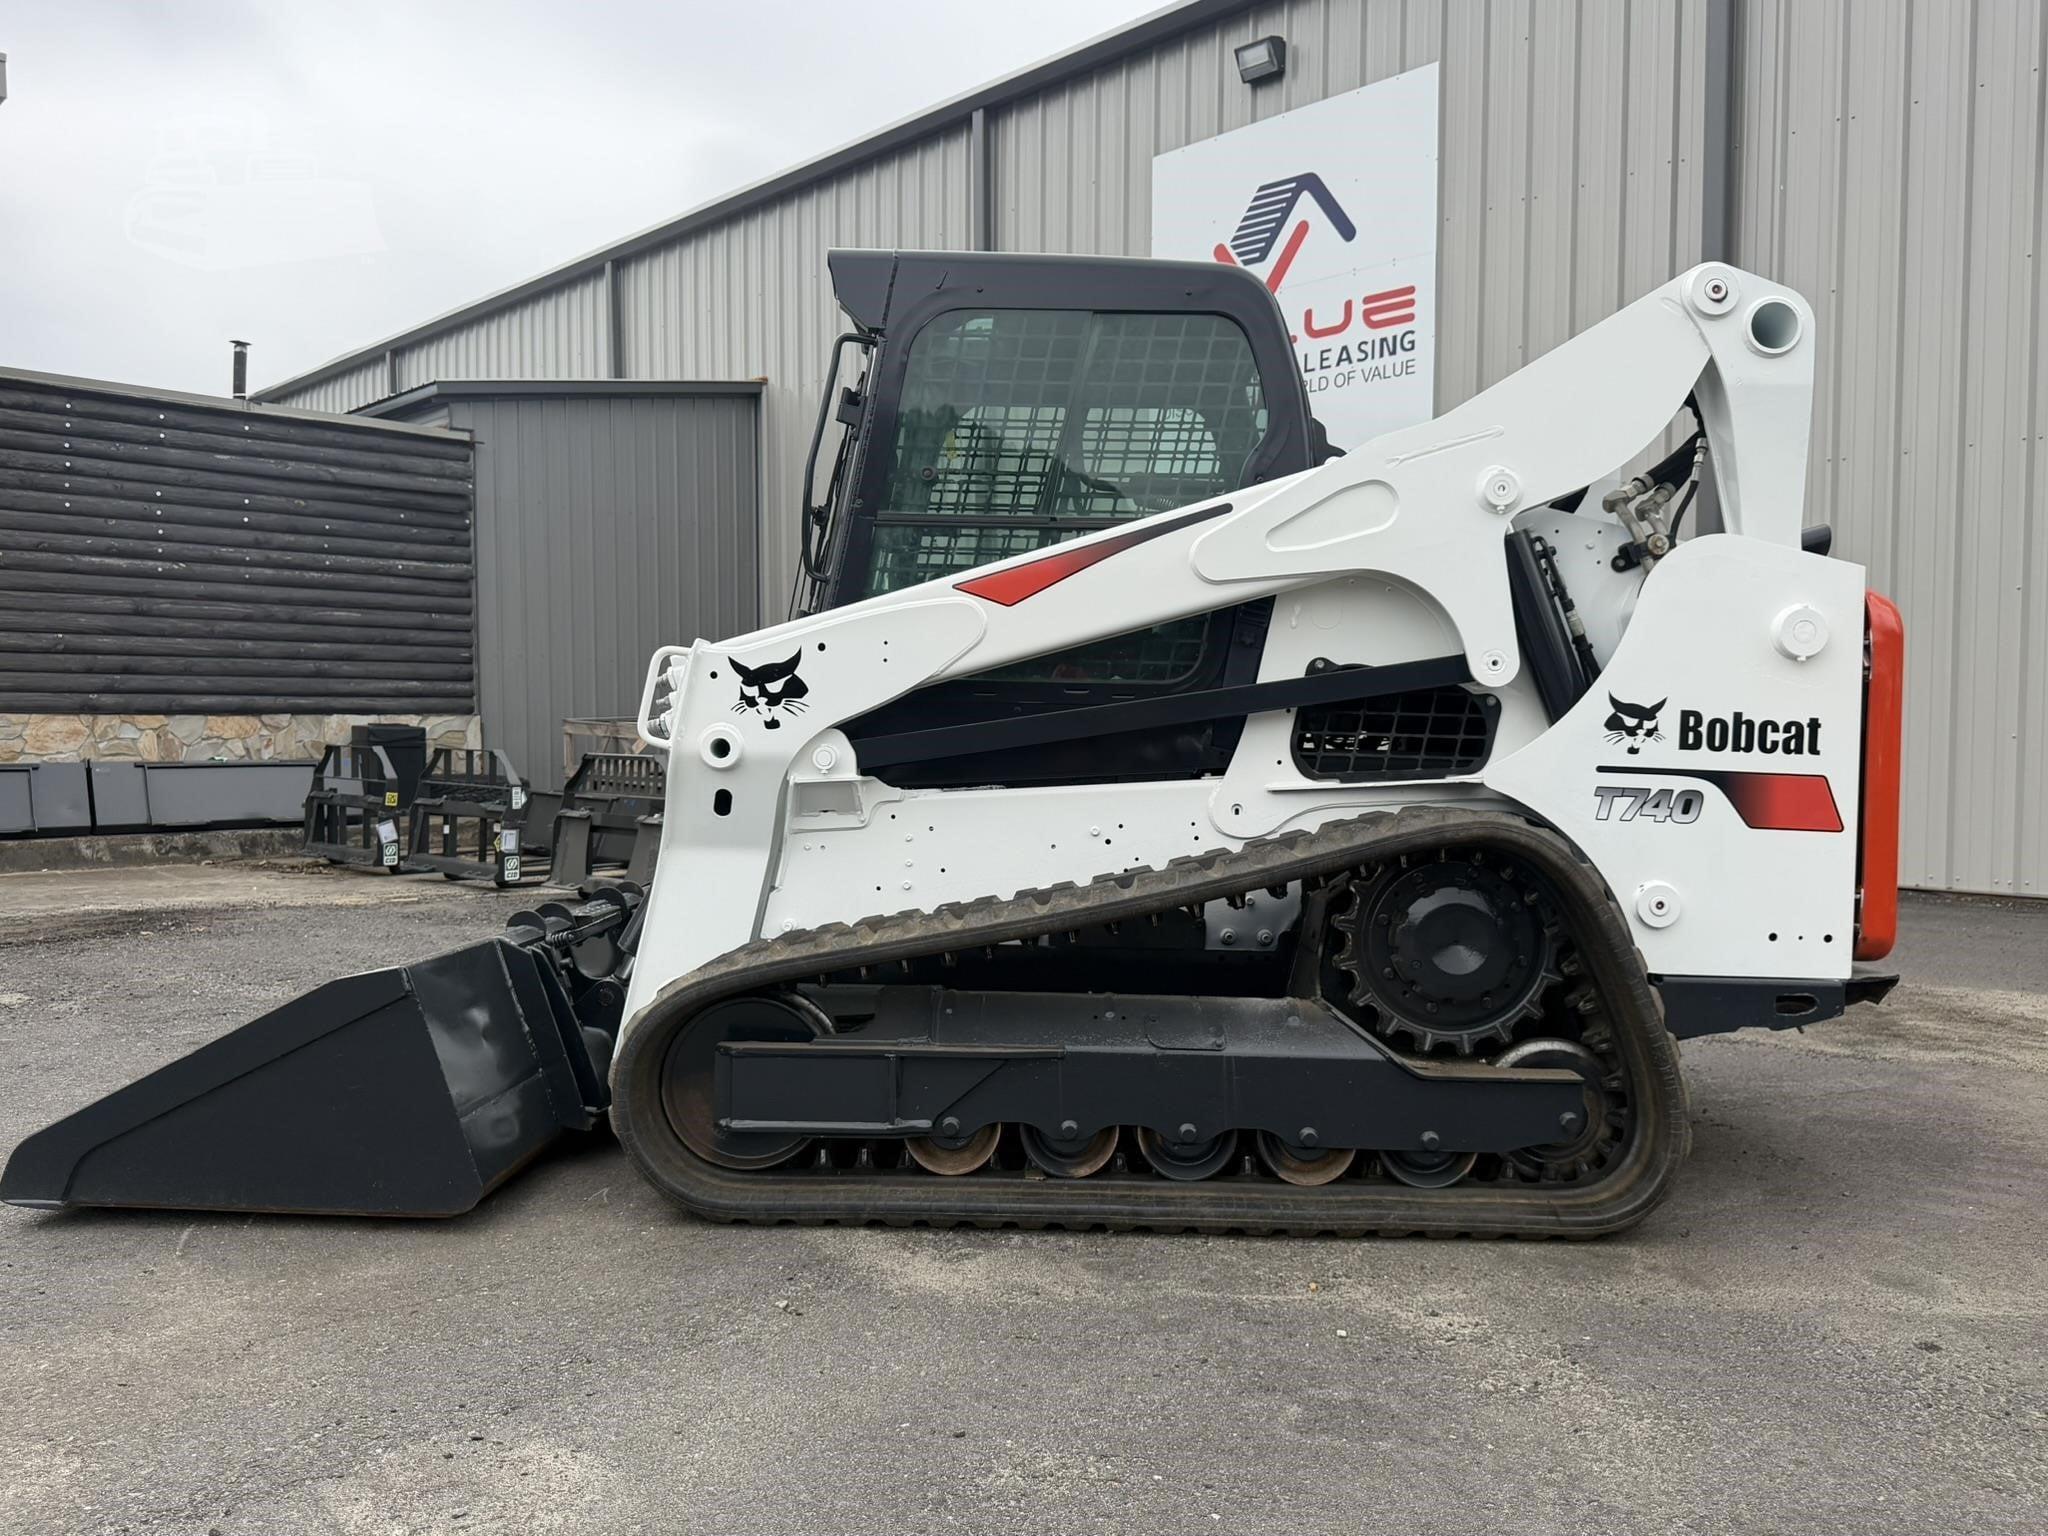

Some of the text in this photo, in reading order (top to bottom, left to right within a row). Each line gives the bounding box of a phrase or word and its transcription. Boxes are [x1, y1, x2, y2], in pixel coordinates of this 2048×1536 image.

[1303, 329, 1416, 374] LEASING
[1333, 369, 1357, 389] OF
[1360, 358, 1416, 384] VALUE
[1678, 709, 1821, 756] Bobcat
[1594, 786, 1704, 824] T740
